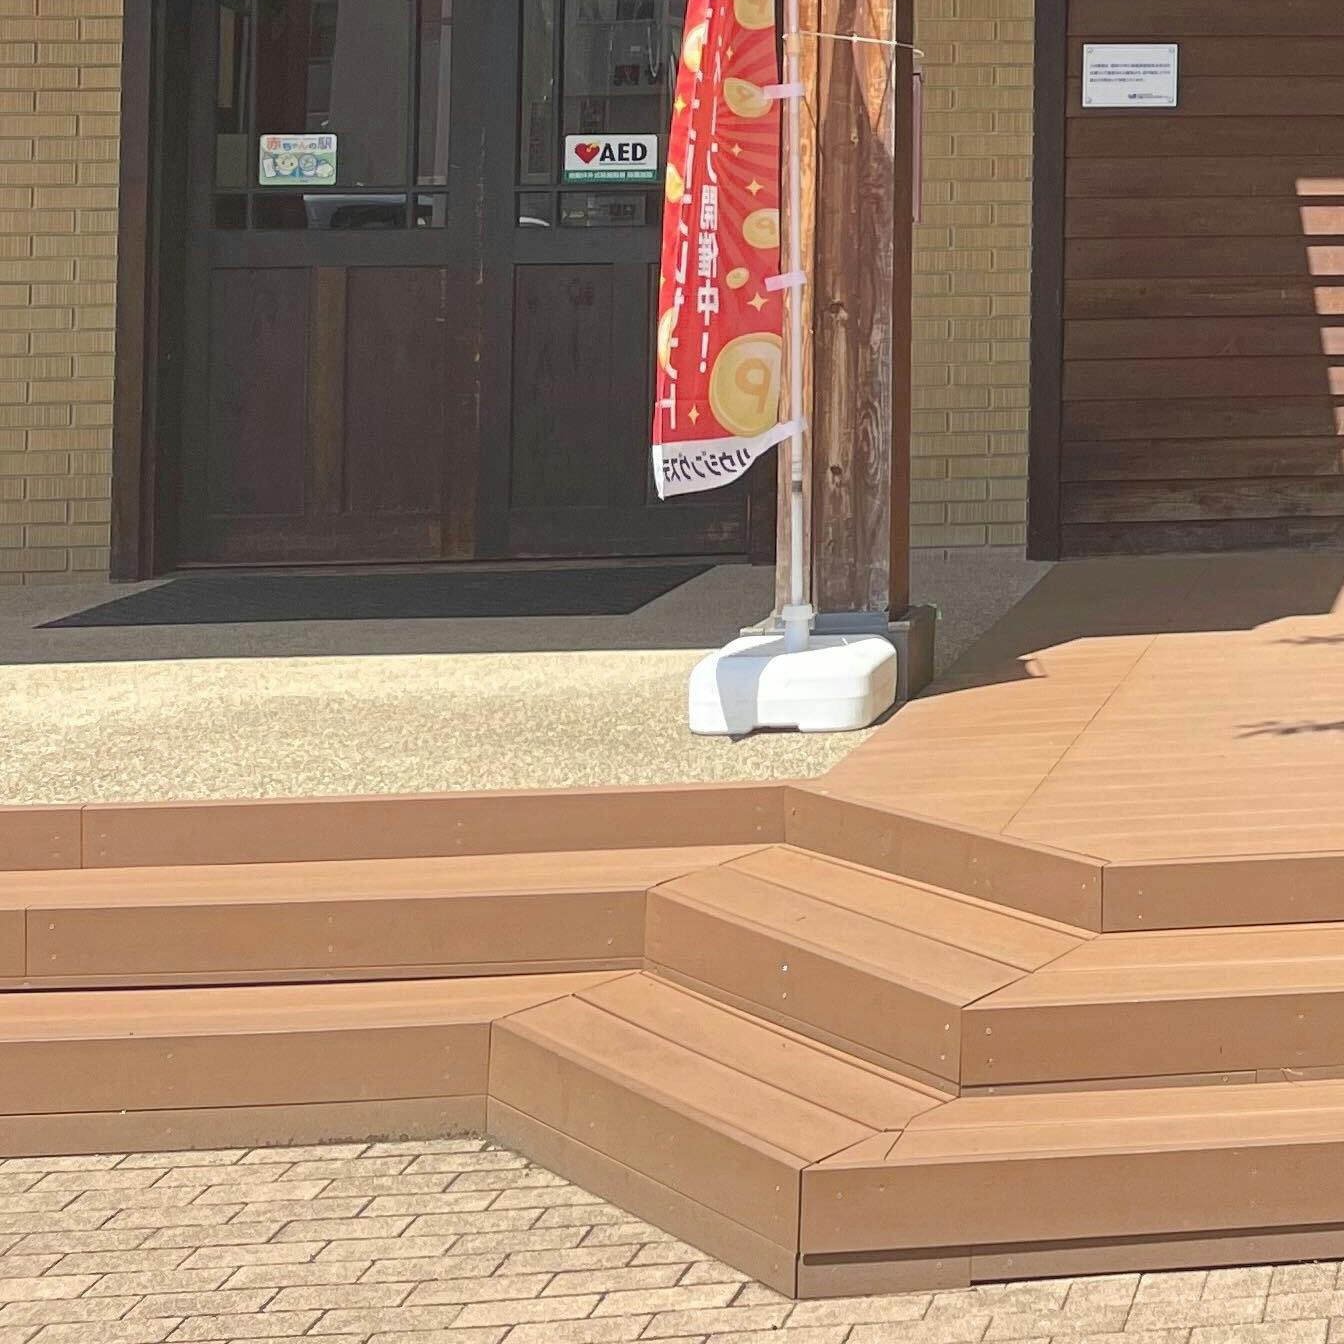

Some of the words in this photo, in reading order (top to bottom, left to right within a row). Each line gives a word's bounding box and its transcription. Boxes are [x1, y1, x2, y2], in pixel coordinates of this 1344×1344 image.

[266, 136, 332, 151] 赤ちゃんの駅
[599, 142, 648, 162] AED
